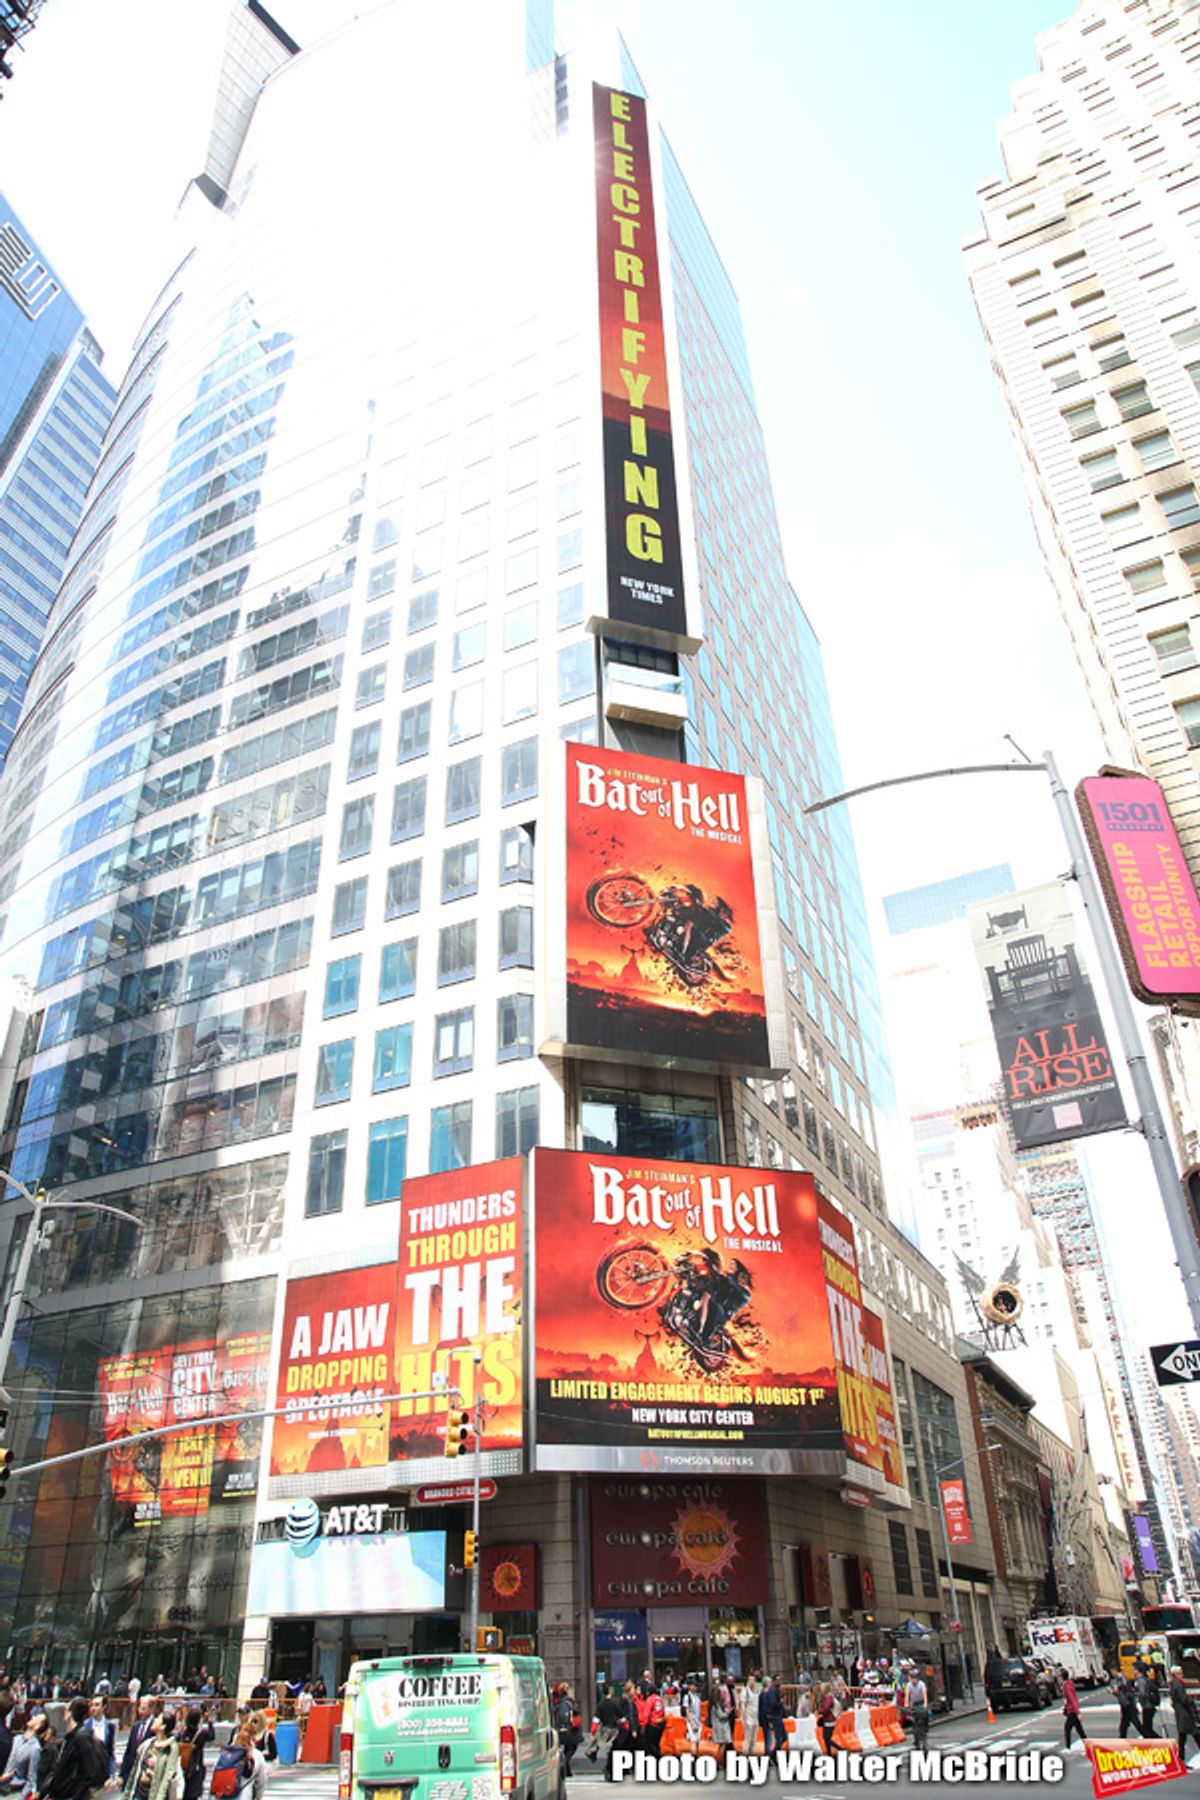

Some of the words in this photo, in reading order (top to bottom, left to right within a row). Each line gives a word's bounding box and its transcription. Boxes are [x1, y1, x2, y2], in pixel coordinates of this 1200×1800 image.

[610, 91, 664, 564] ELECTRIFYING
[620, 576, 645, 589] NEW
[646, 582, 675, 598] YORK
[631, 588, 664, 606] TIMES
[575, 760, 648, 817] Bat
[639, 787, 664, 804] out
[671, 780, 741, 832] Hell
[1096, 802, 1161, 822] 1501
[1112, 842, 1169, 968] FLAGSHIP
[1147, 879, 1193, 968] RETAIL
[1010, 1023, 1098, 1069] ALL
[1005, 1047, 1114, 1099] RISE
[408, 1189, 515, 1234] THUNDERS
[588, 1163, 674, 1230] Bat
[664, 1187, 693, 1213] out
[685, 1205, 701, 1229] of
[699, 1175, 782, 1244] Hell
[406, 1221, 516, 1267] THROUGH
[723, 1237, 740, 1250] THE
[742, 1238, 784, 1253] MUSICAL
[404, 1256, 515, 1345] THE
[289, 1316, 311, 1359] A
[318, 1302, 389, 1356] JAW
[286, 1354, 388, 1393] DROPPING
[1172, 1352, 1200, 1371] ON
[550, 1379, 608, 1399] LIMITED
[610, 1381, 701, 1403] ENGAGEMENT
[703, 1384, 753, 1404] BEGINS
[755, 1386, 807, 1406] AUGUST
[631, 1408, 657, 1423] NEW
[658, 1408, 687, 1423] YORK
[688, 1409, 713, 1424] CITY
[716, 1409, 754, 1425] CENTER
[664, 1455, 711, 1466] THOMSON
[712, 1455, 754, 1466] REUTERS
[324, 1503, 389, 1535] AT&T
[607, 1579, 682, 1599] europa
[1032, 1628, 1077, 1647] FedEx
[398, 1674, 482, 1699] COFFEE
